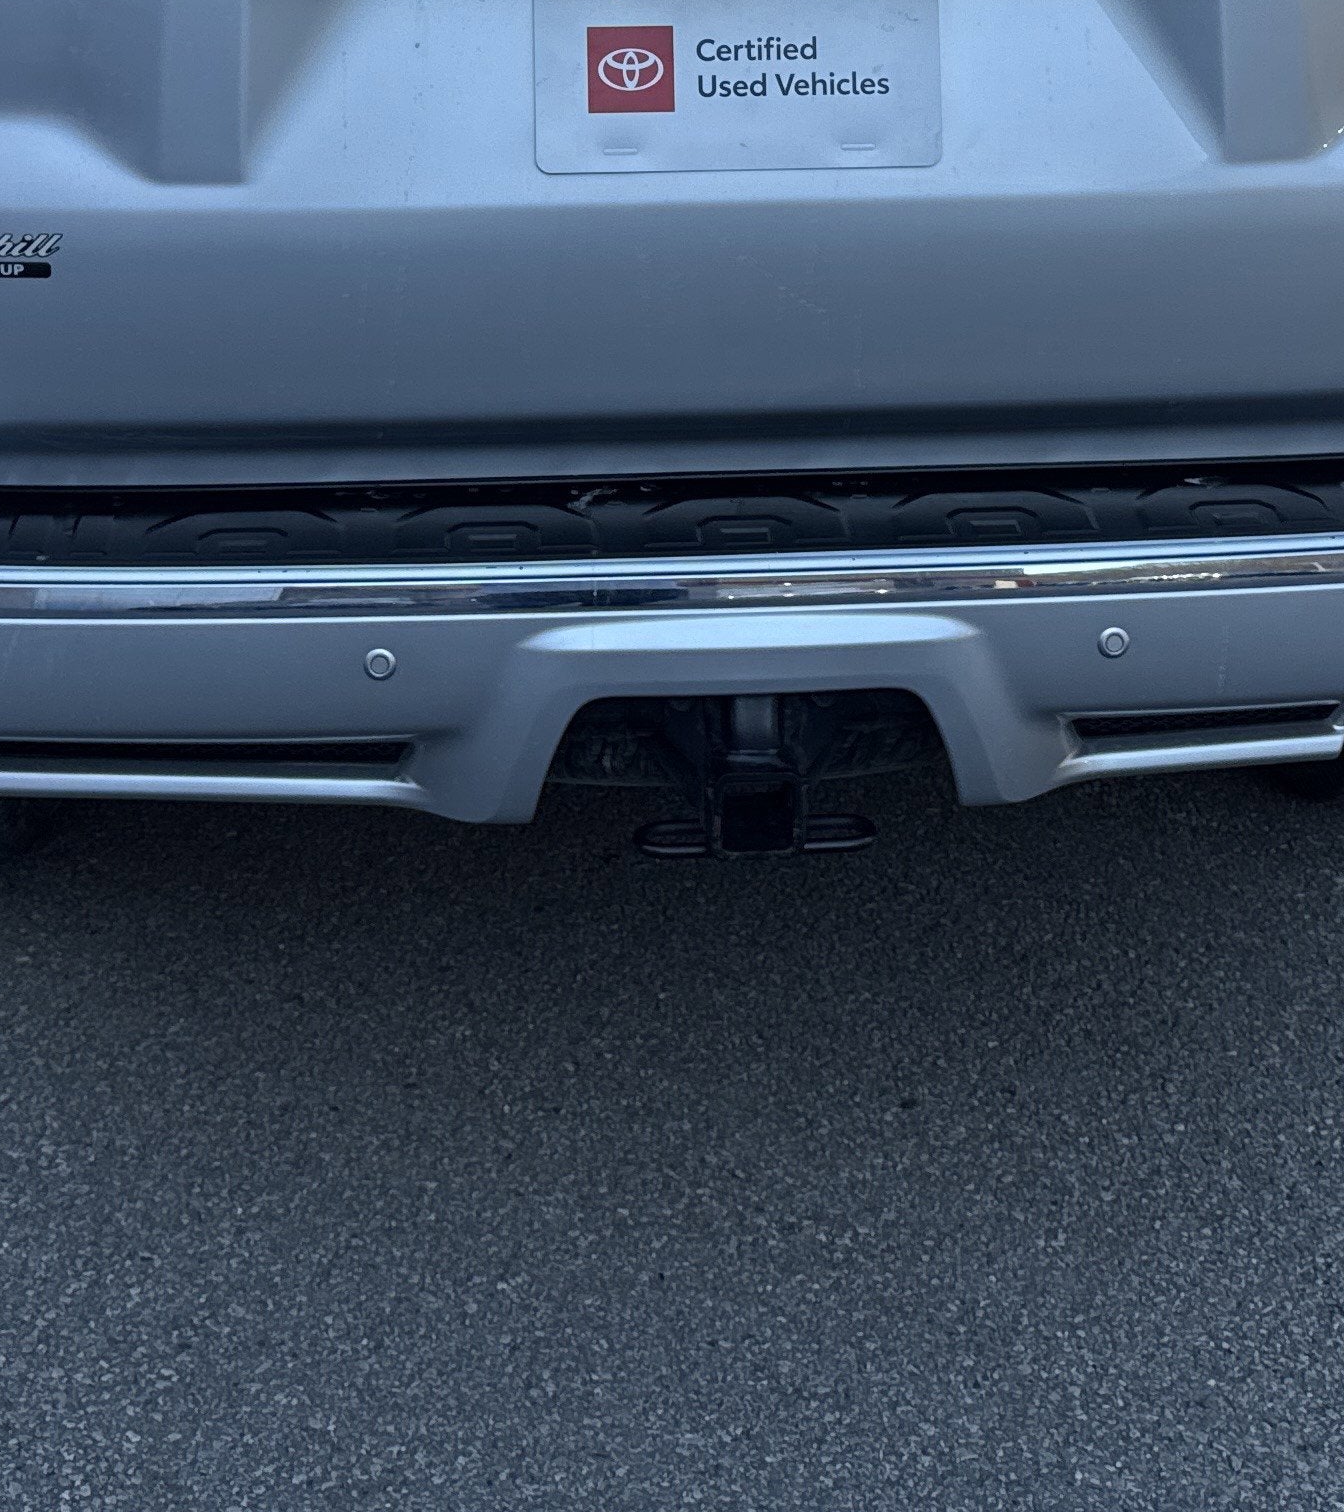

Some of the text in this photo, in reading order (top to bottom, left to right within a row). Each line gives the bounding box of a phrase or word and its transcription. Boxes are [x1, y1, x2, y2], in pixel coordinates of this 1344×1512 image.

[696, 36, 817, 61] Certified
[697, 71, 890, 97] Used Vehicles
